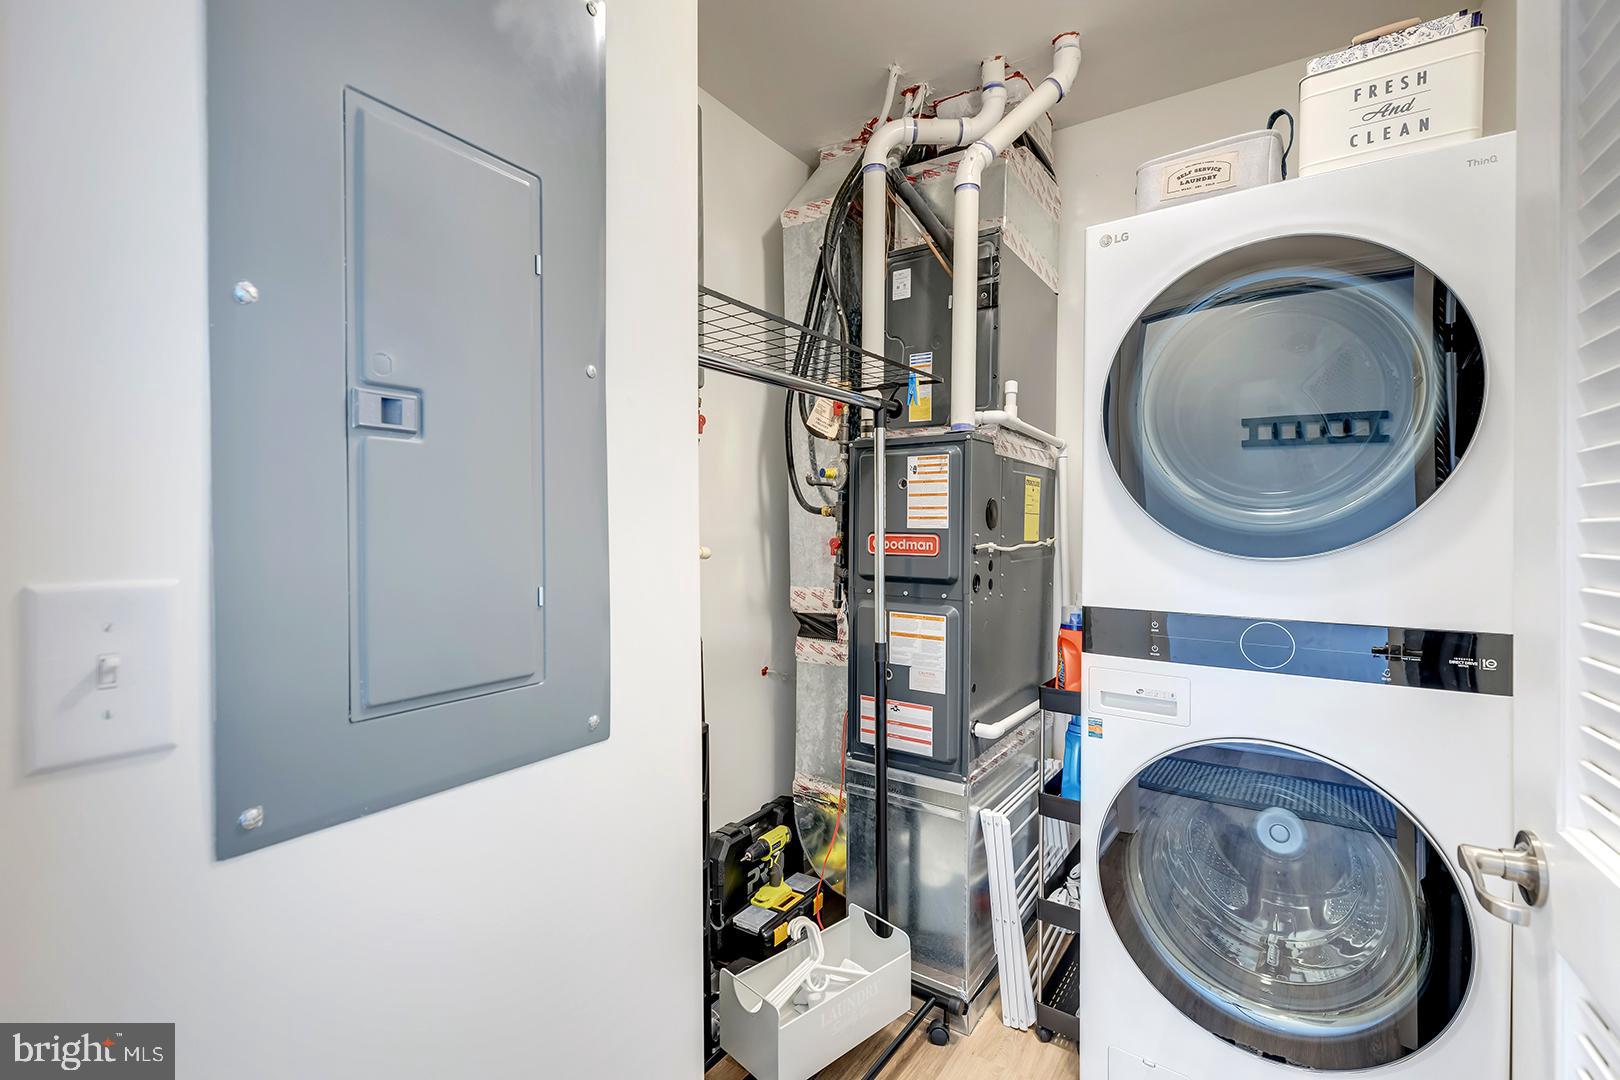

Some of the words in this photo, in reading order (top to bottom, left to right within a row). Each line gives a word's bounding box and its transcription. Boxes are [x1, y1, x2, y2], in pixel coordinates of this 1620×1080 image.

[1353, 70, 1428, 103] FRESH
[1361, 97, 1416, 122] And
[1349, 117, 1430, 148] CLEAN
[1466, 154, 1499, 168] ThinQ
[1176, 170, 1192, 180] SELF
[1179, 174, 1218, 186] LAUNDRY
[1114, 232, 1129, 244] LG
[872, 538, 934, 551] oodman
